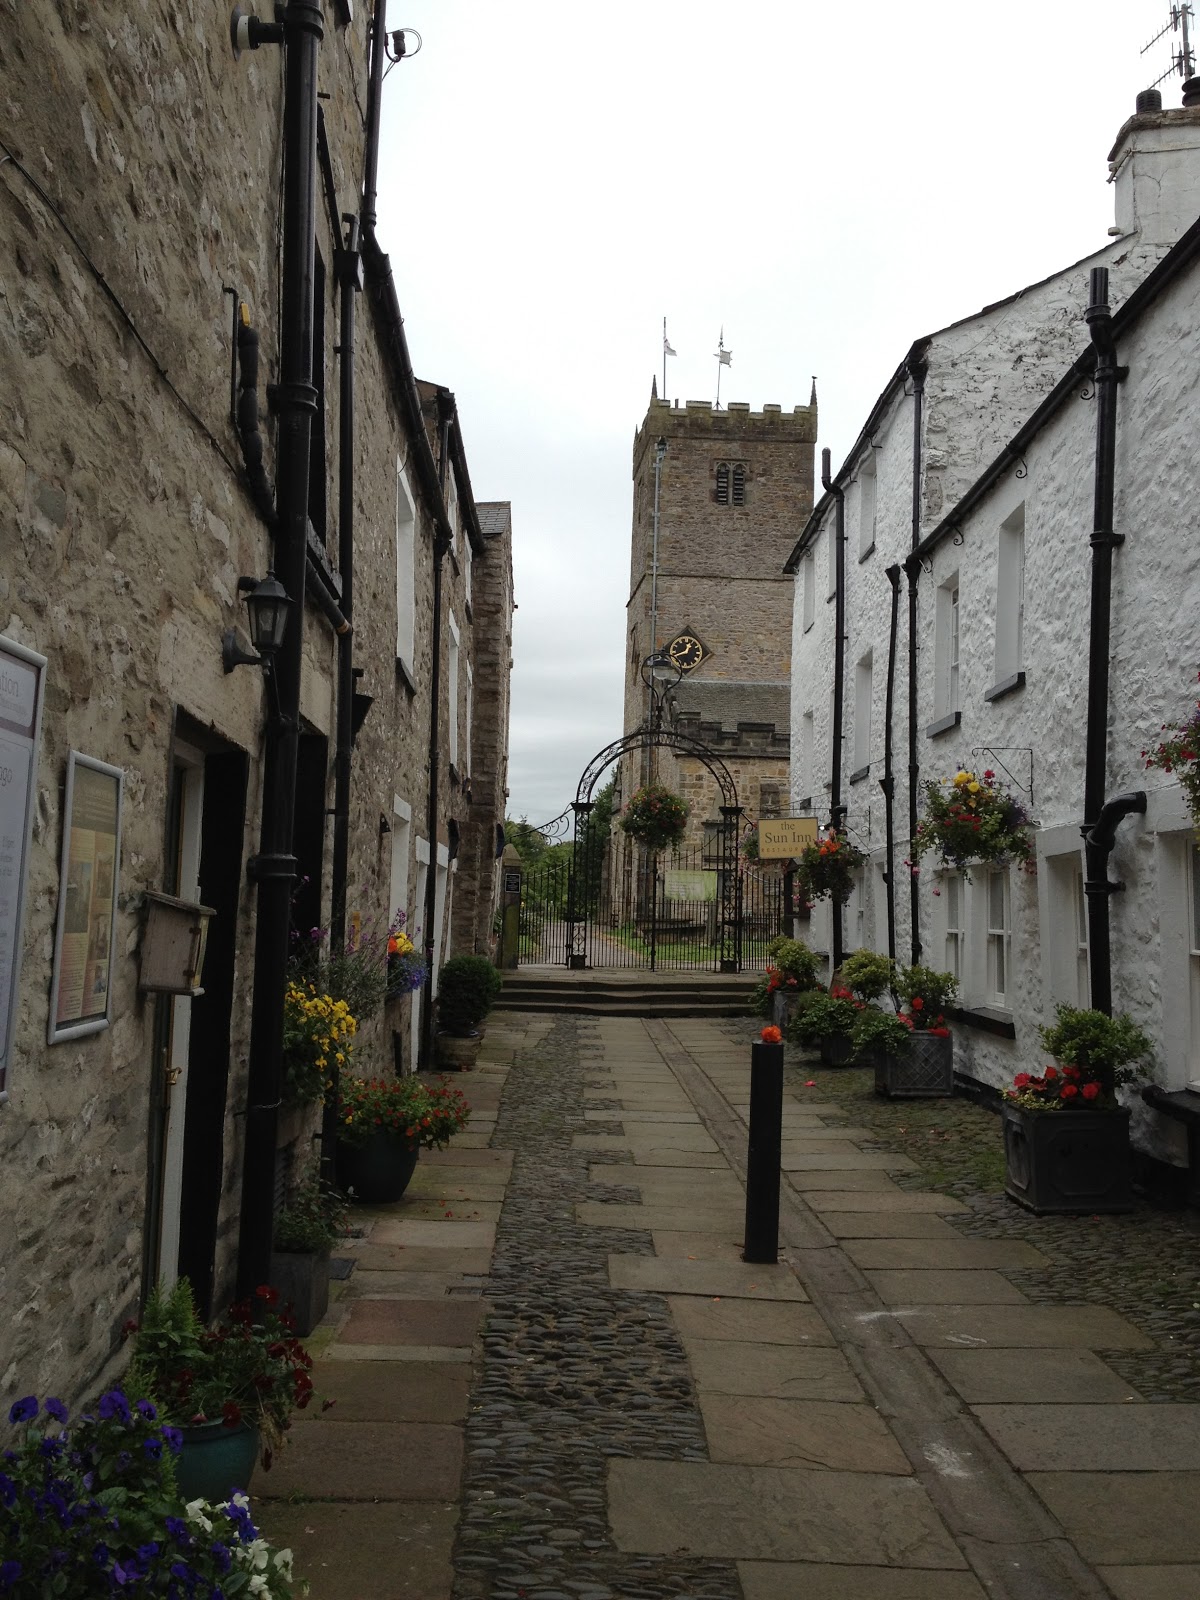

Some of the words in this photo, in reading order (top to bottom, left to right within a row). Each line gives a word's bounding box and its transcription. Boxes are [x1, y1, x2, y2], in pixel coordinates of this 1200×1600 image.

[0, 670, 18, 698] tion
[781, 821, 795, 830] the
[765, 832, 788, 843] Sun
[792, 832, 812, 842] Inn
